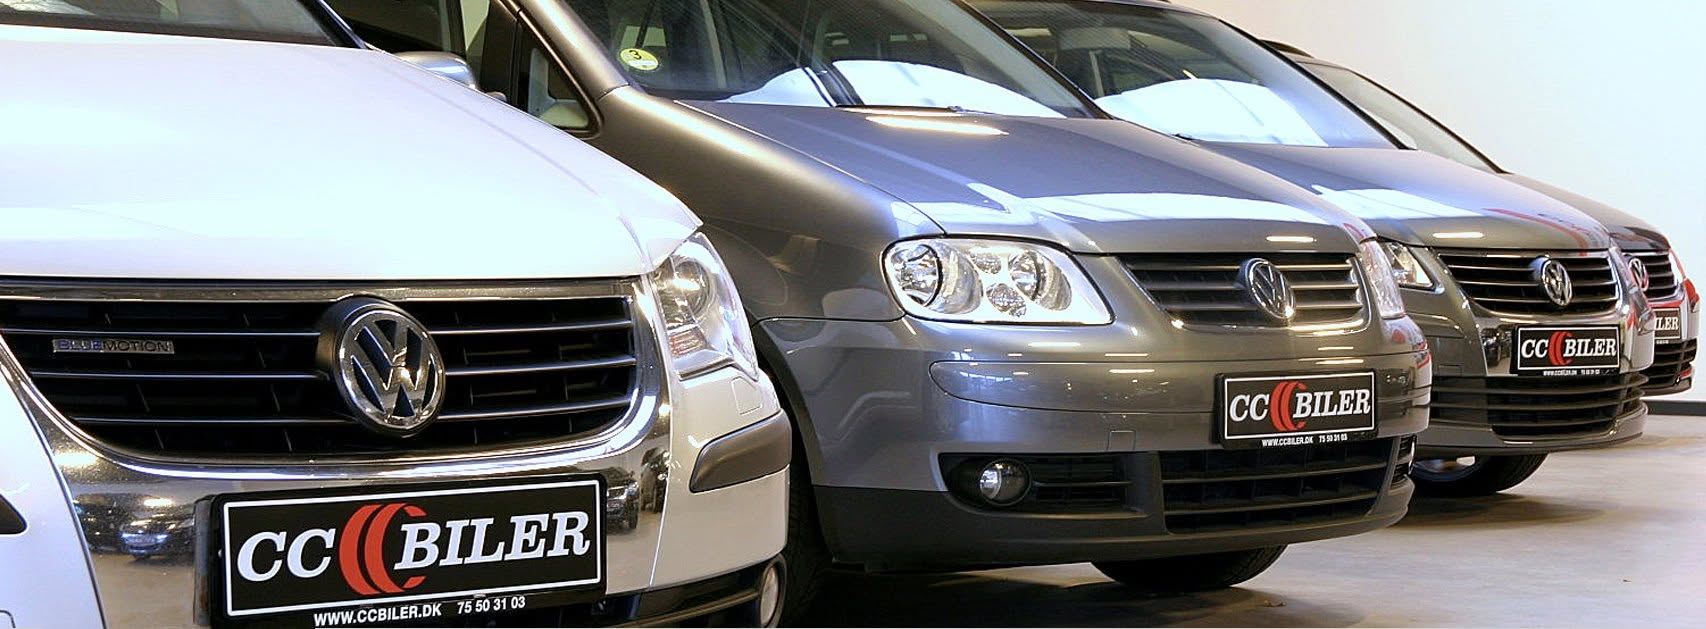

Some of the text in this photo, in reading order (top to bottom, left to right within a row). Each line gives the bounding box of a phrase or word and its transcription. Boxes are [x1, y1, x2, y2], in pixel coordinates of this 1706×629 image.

[628, 49, 642, 60] 3
[1654, 316, 1679, 330] ILER
[58, 340, 170, 351] BLUEMOTION
[1563, 337, 1617, 357] BILER
[1292, 388, 1371, 418] BILER
[1261, 435, 1314, 447] WWW.CCBILER.DK
[393, 511, 591, 571] BILER
[314, 596, 526, 627] WWW.CCBILER.DK 75 50 31 03
